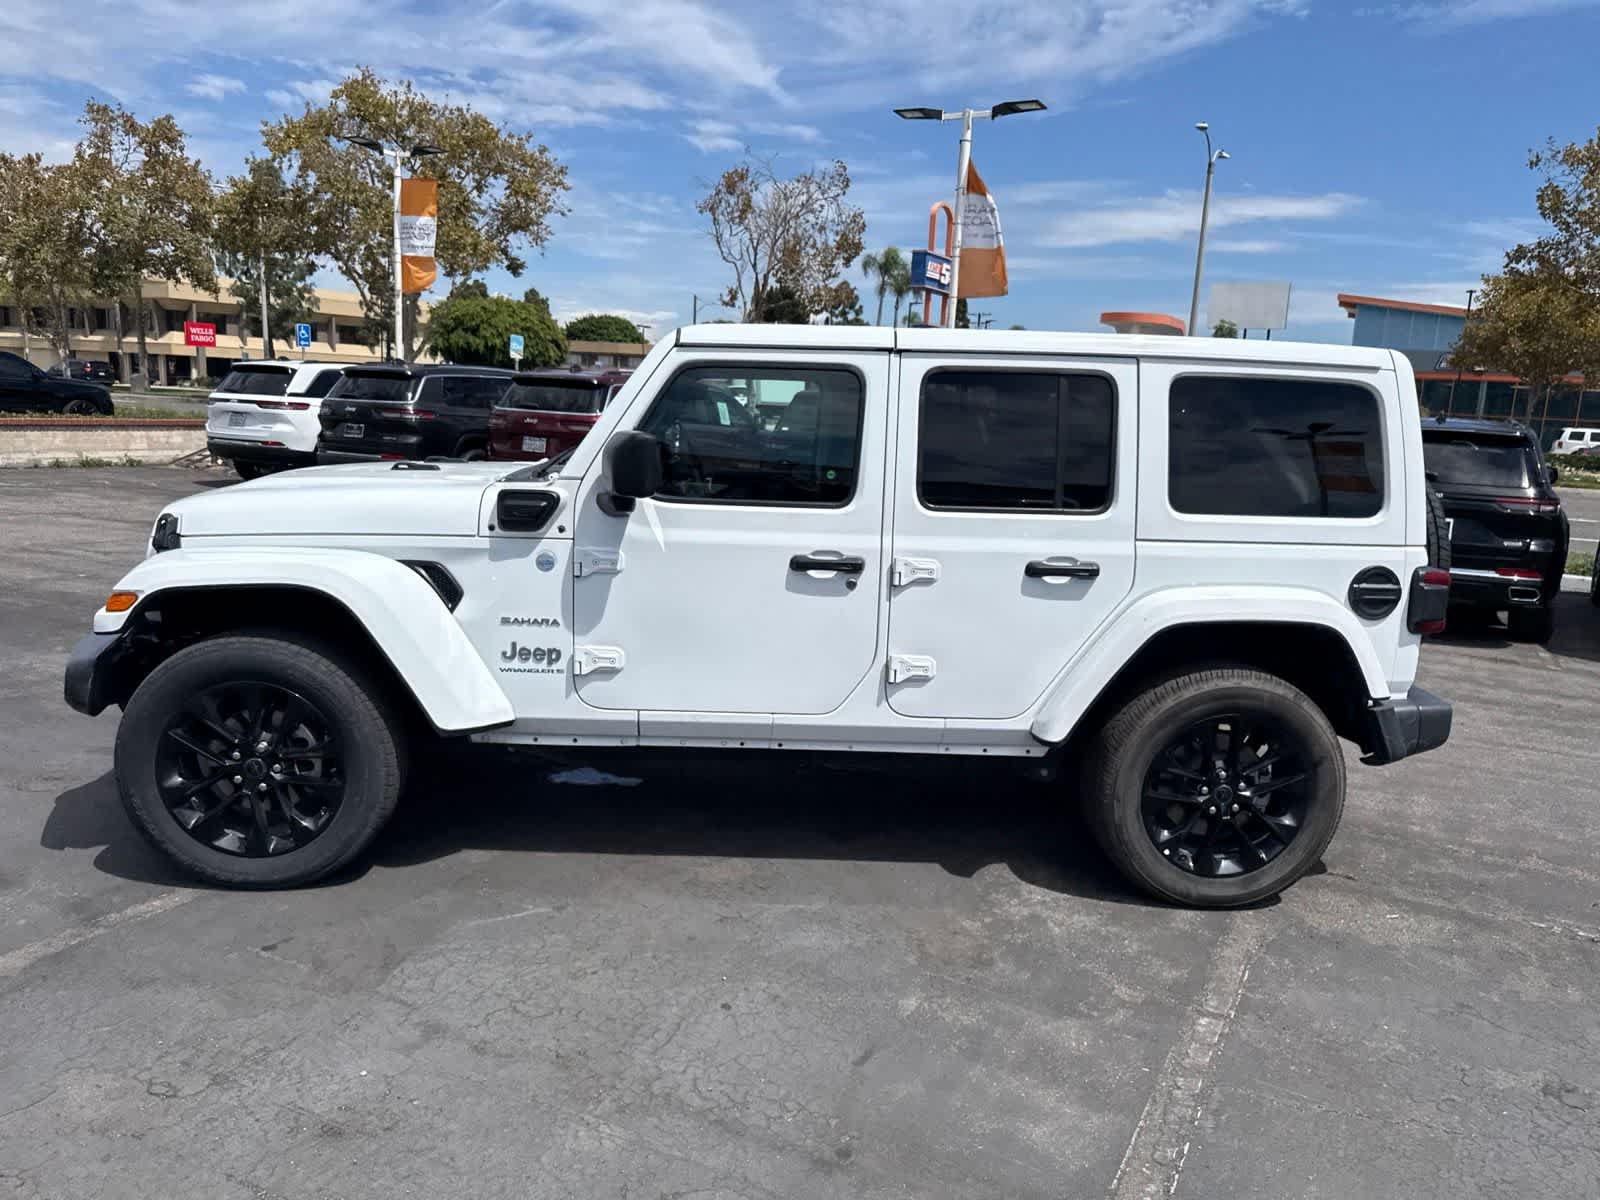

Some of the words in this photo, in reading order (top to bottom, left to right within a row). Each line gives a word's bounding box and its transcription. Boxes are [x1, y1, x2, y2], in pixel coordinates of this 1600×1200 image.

[191, 335, 214, 343] FARGO
[500, 617, 560, 626] SAHARA
[501, 641, 561, 666] Jeep
